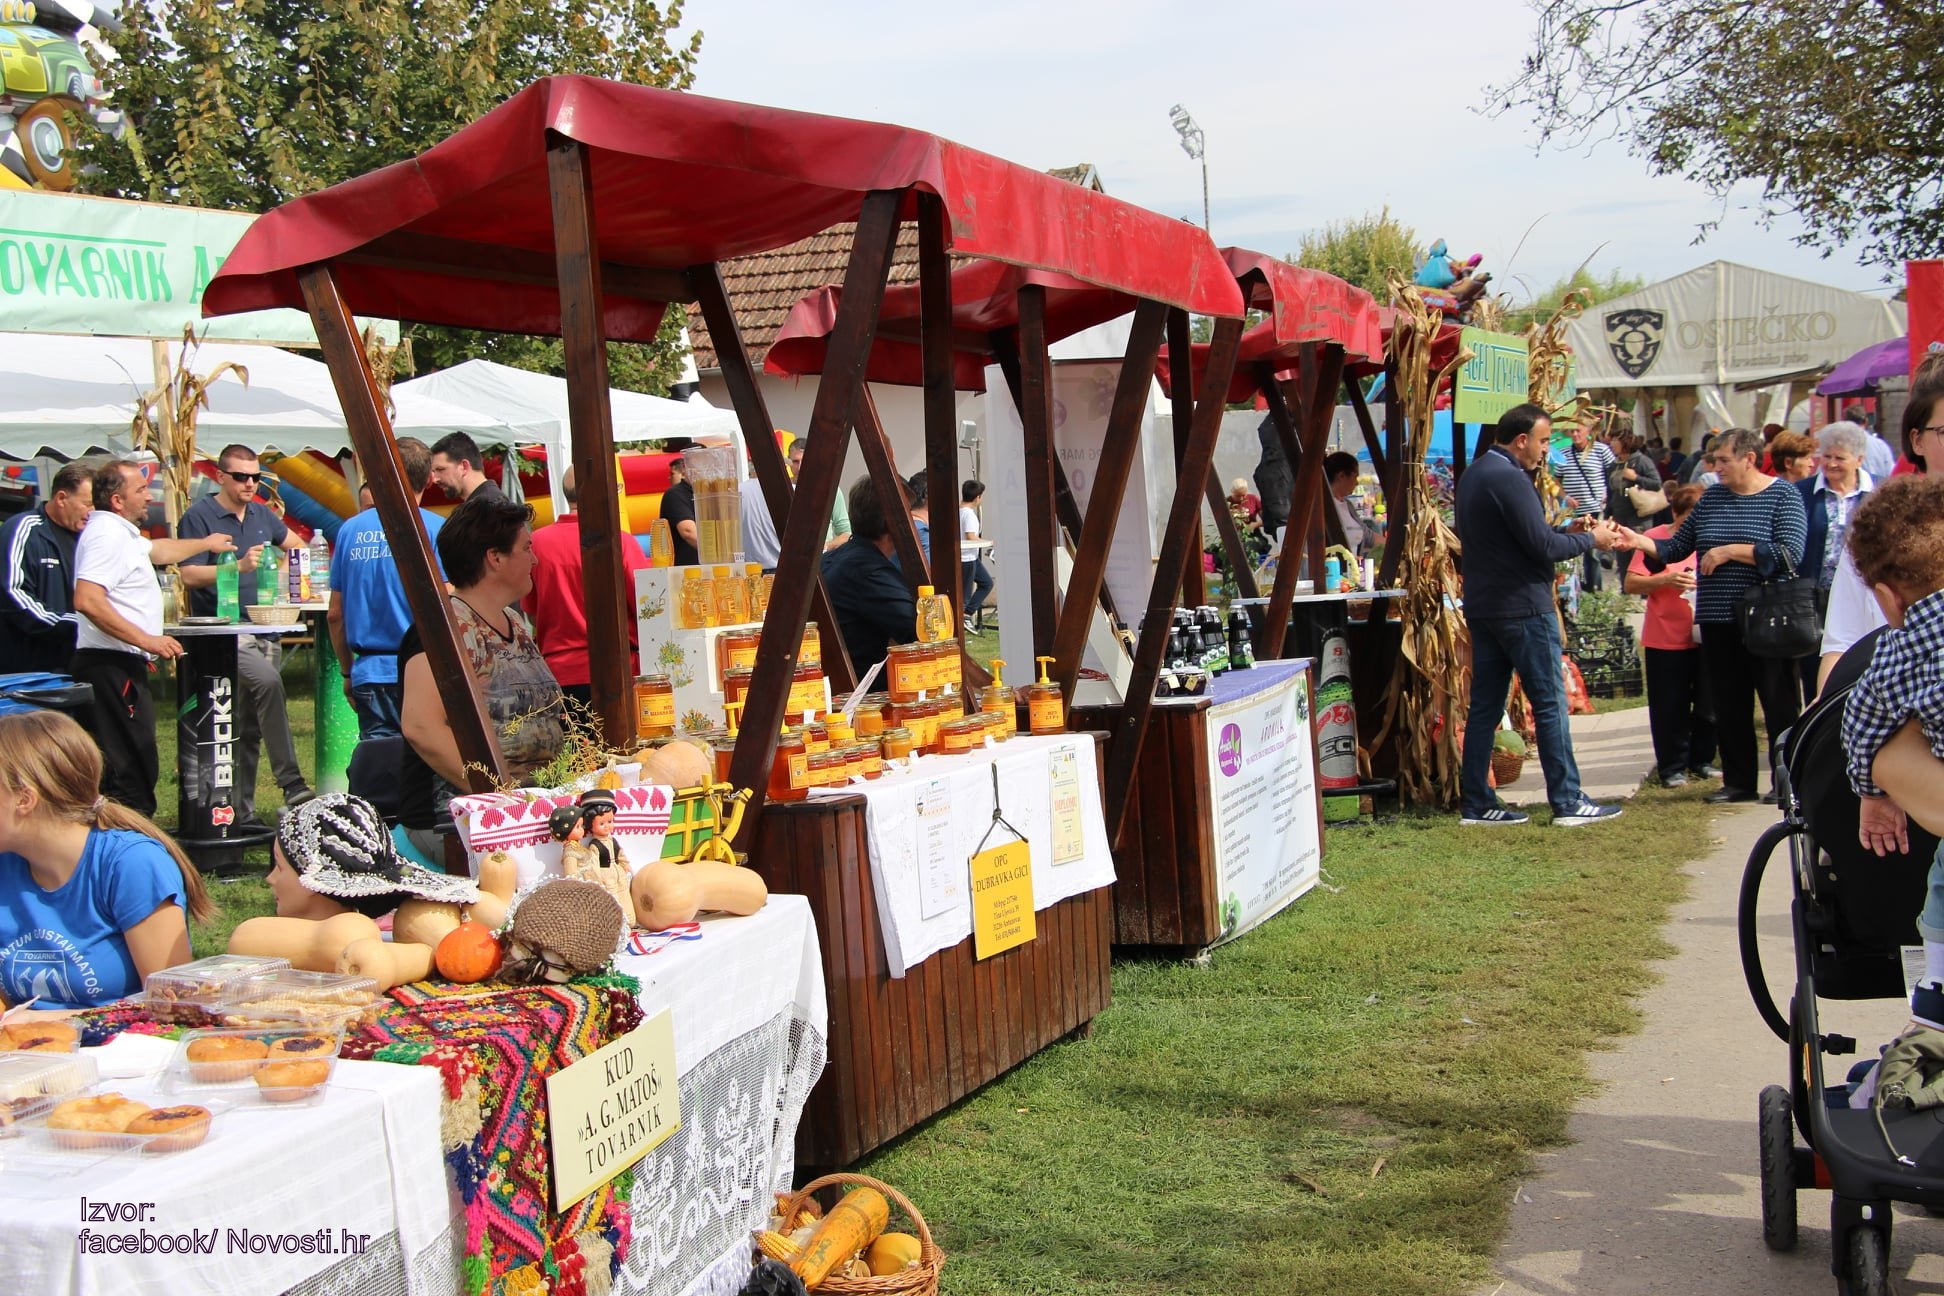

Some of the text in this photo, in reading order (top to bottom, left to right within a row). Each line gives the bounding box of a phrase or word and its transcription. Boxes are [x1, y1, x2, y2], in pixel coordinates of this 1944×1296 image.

[1676, 305, 1836, 351] OSJEČKO
[208, 676, 233, 788] BECK'S
[976, 871, 1013, 892] DUBRAVKA
[993, 853, 1008, 868] OPG
[70, 951, 103, 995] MATOŠ
[603, 1046, 634, 1088] KUD
[600, 1098, 615, 1129] G.
[585, 1103, 662, 1175] TOVARNIK
